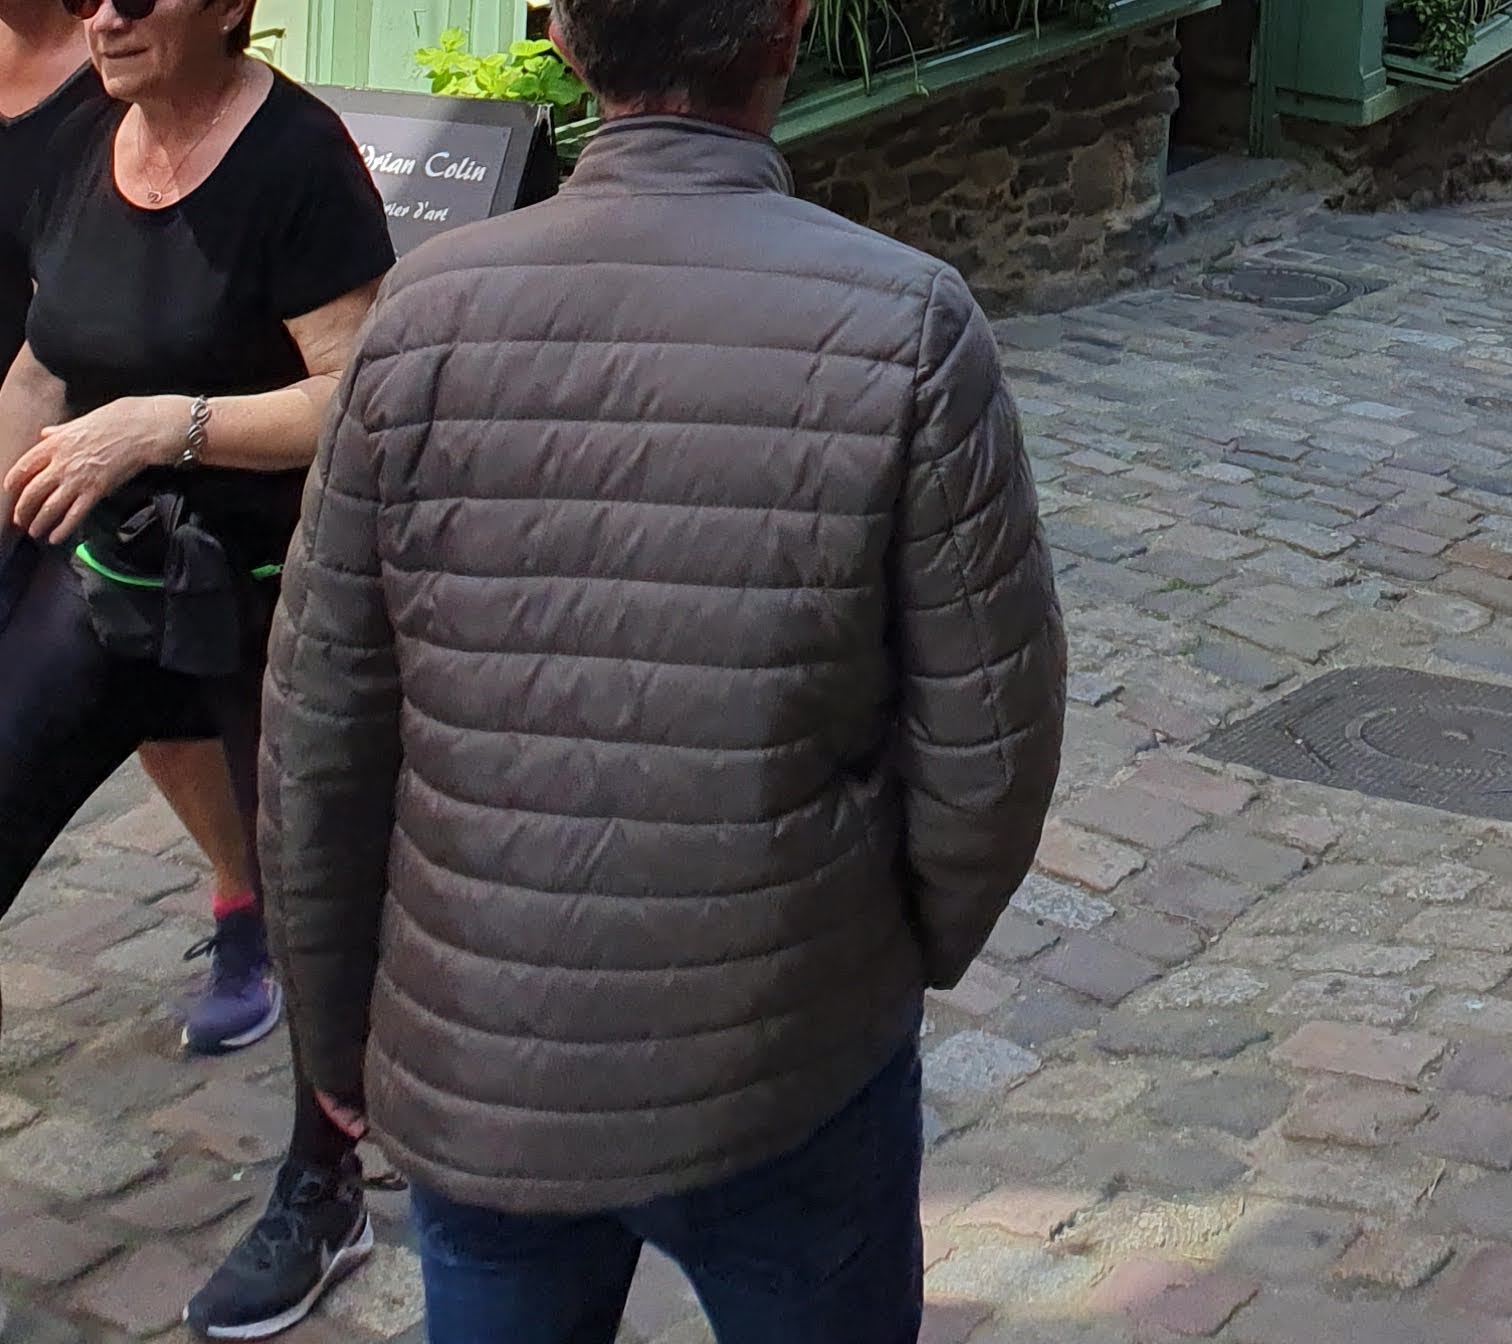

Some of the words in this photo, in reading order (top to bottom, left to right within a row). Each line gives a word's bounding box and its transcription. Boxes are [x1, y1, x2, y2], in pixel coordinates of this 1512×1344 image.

[359, 143, 416, 175] drian
[425, 150, 488, 182] Colin
[413, 200, 449, 222] d'art
